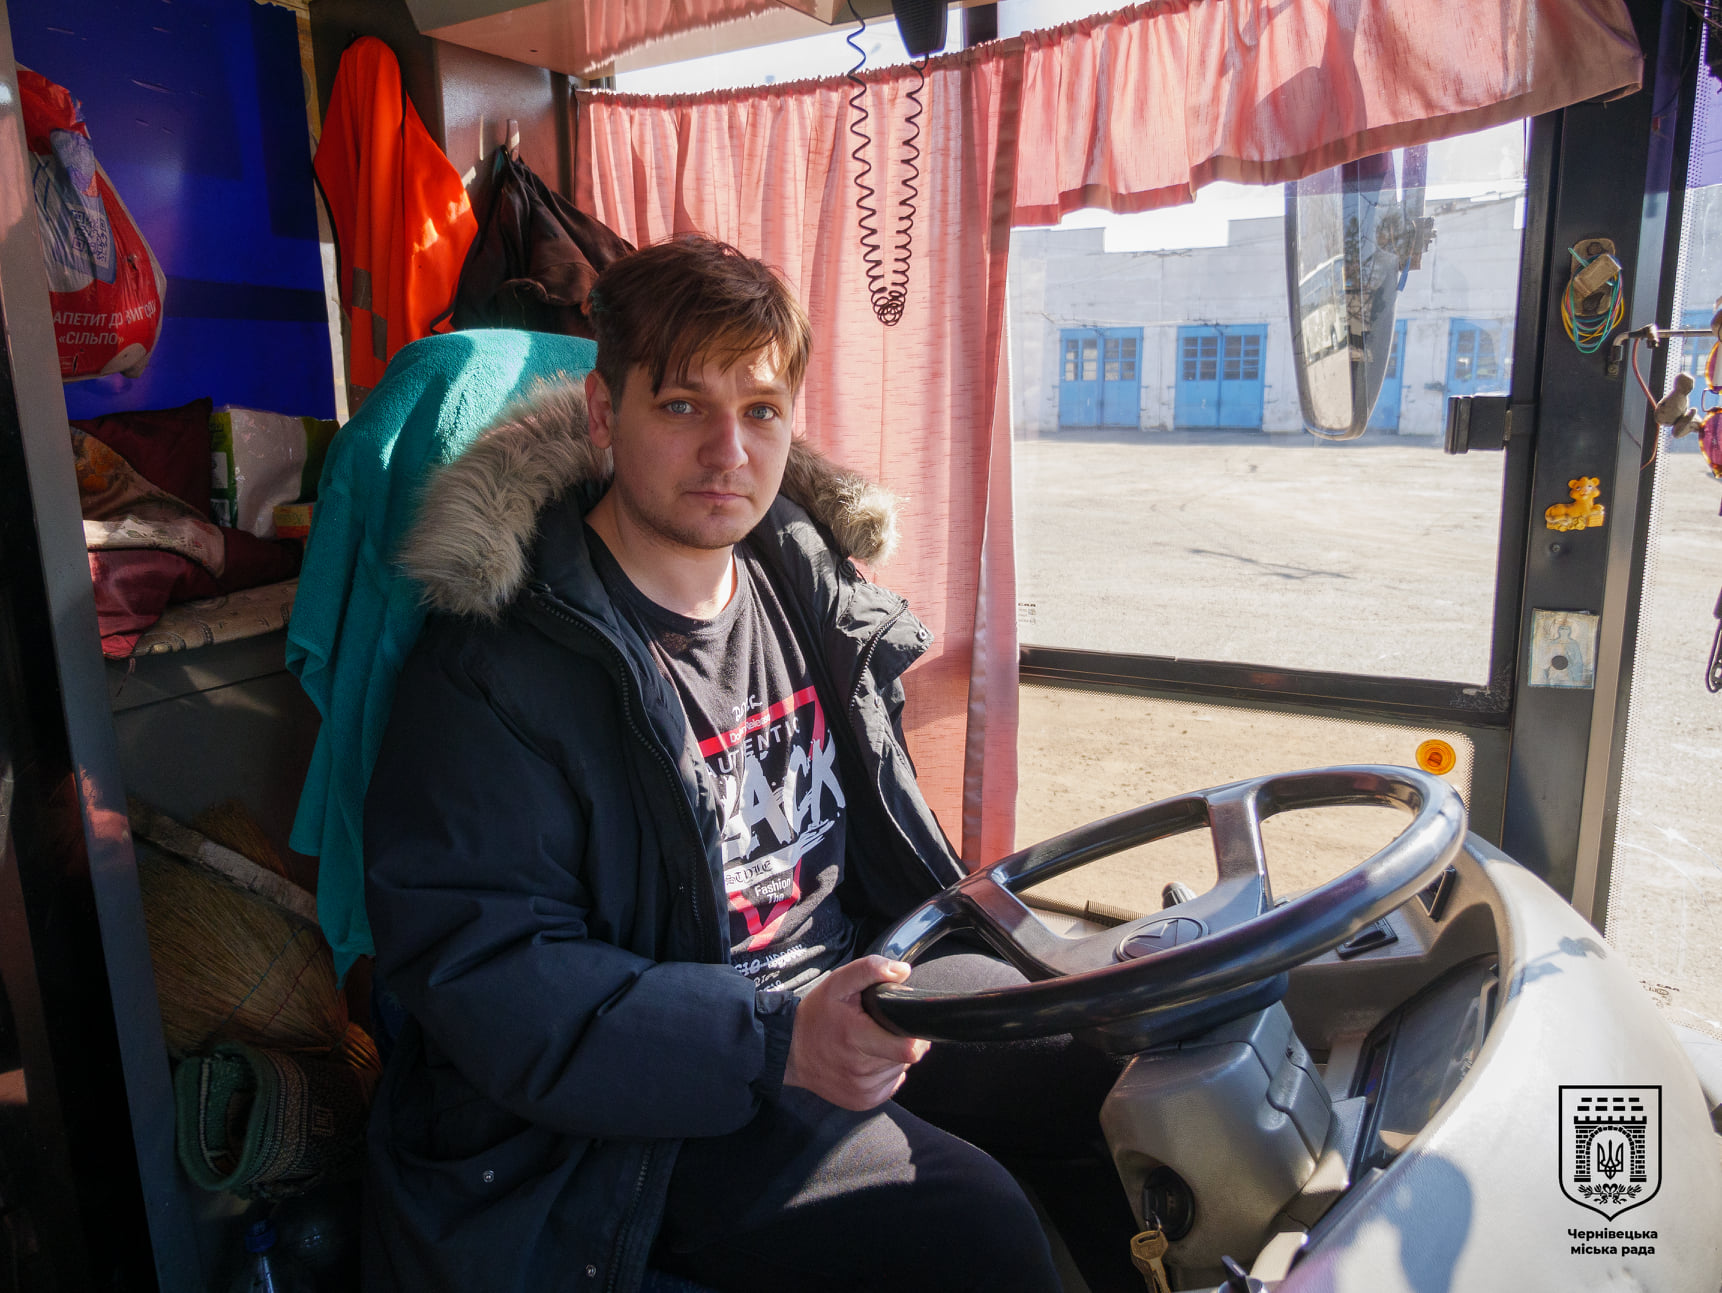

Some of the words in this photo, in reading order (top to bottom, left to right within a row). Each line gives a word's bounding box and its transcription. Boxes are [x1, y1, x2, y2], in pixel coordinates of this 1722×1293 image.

[53, 311, 108, 327] АПЕТИТ
[108, 312, 123, 329] ДО
[58, 331, 124, 345] «СІЛЬПО»
[754, 878, 791, 897] Fashion
